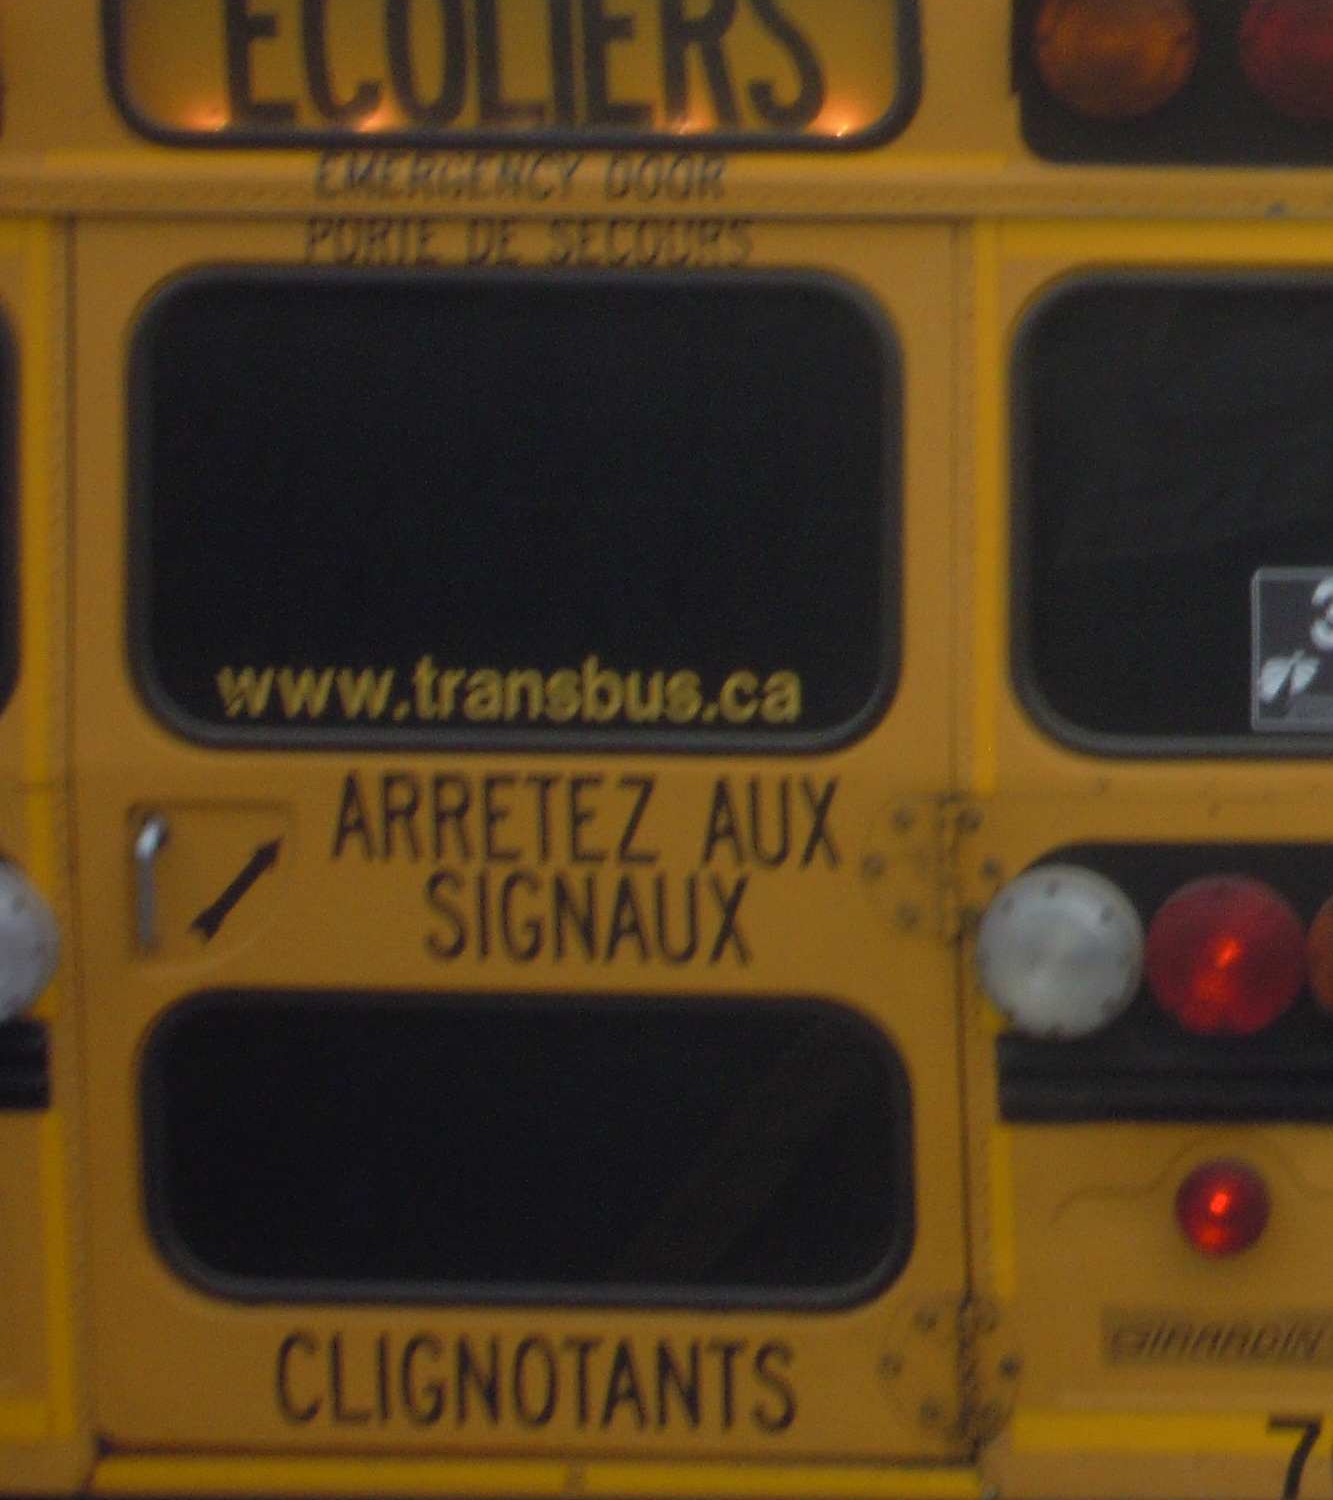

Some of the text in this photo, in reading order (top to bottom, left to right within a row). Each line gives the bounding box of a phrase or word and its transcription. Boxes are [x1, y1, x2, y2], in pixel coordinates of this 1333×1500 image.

[314, 150, 726, 201] EMERGENCY DOOR
[303, 216, 754, 268] PORTE DE SECOURS
[217, 654, 802, 723] www.transbus.ca
[331, 770, 841, 870] ARRETEZ AUX
[424, 871, 752, 965] SIGNAUX
[276, 1331, 796, 1433] CLIGNOTANTS
